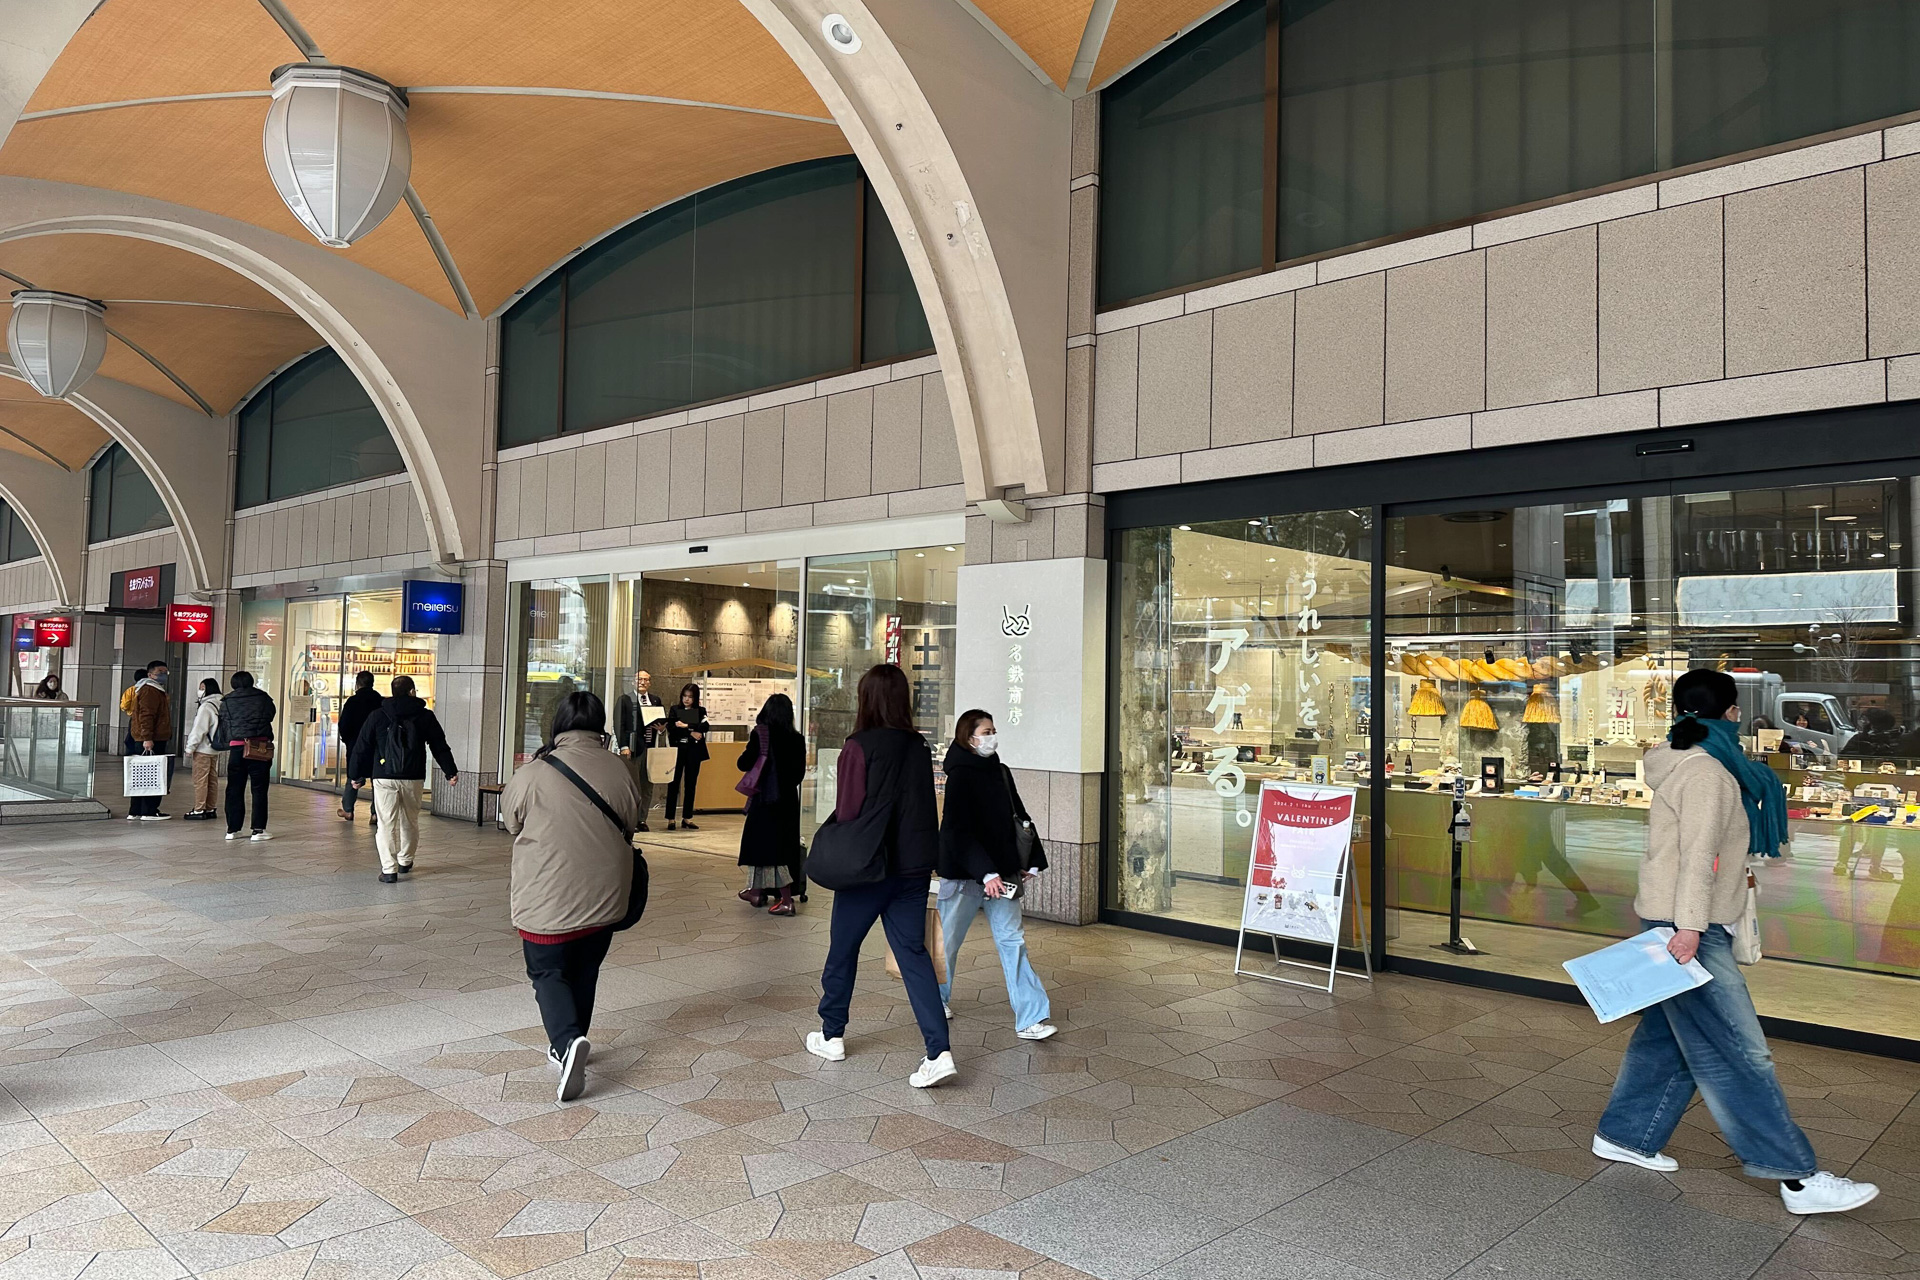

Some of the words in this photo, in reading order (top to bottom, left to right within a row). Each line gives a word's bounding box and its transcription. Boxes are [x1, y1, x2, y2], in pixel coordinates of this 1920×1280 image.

[1007, 643, 1024, 726] 名鉄商店
[1299, 571, 1321, 742] うれしいを、
[1206, 627, 1252, 829] アゲる。
[1276, 813, 1334, 825] VALENTINE
